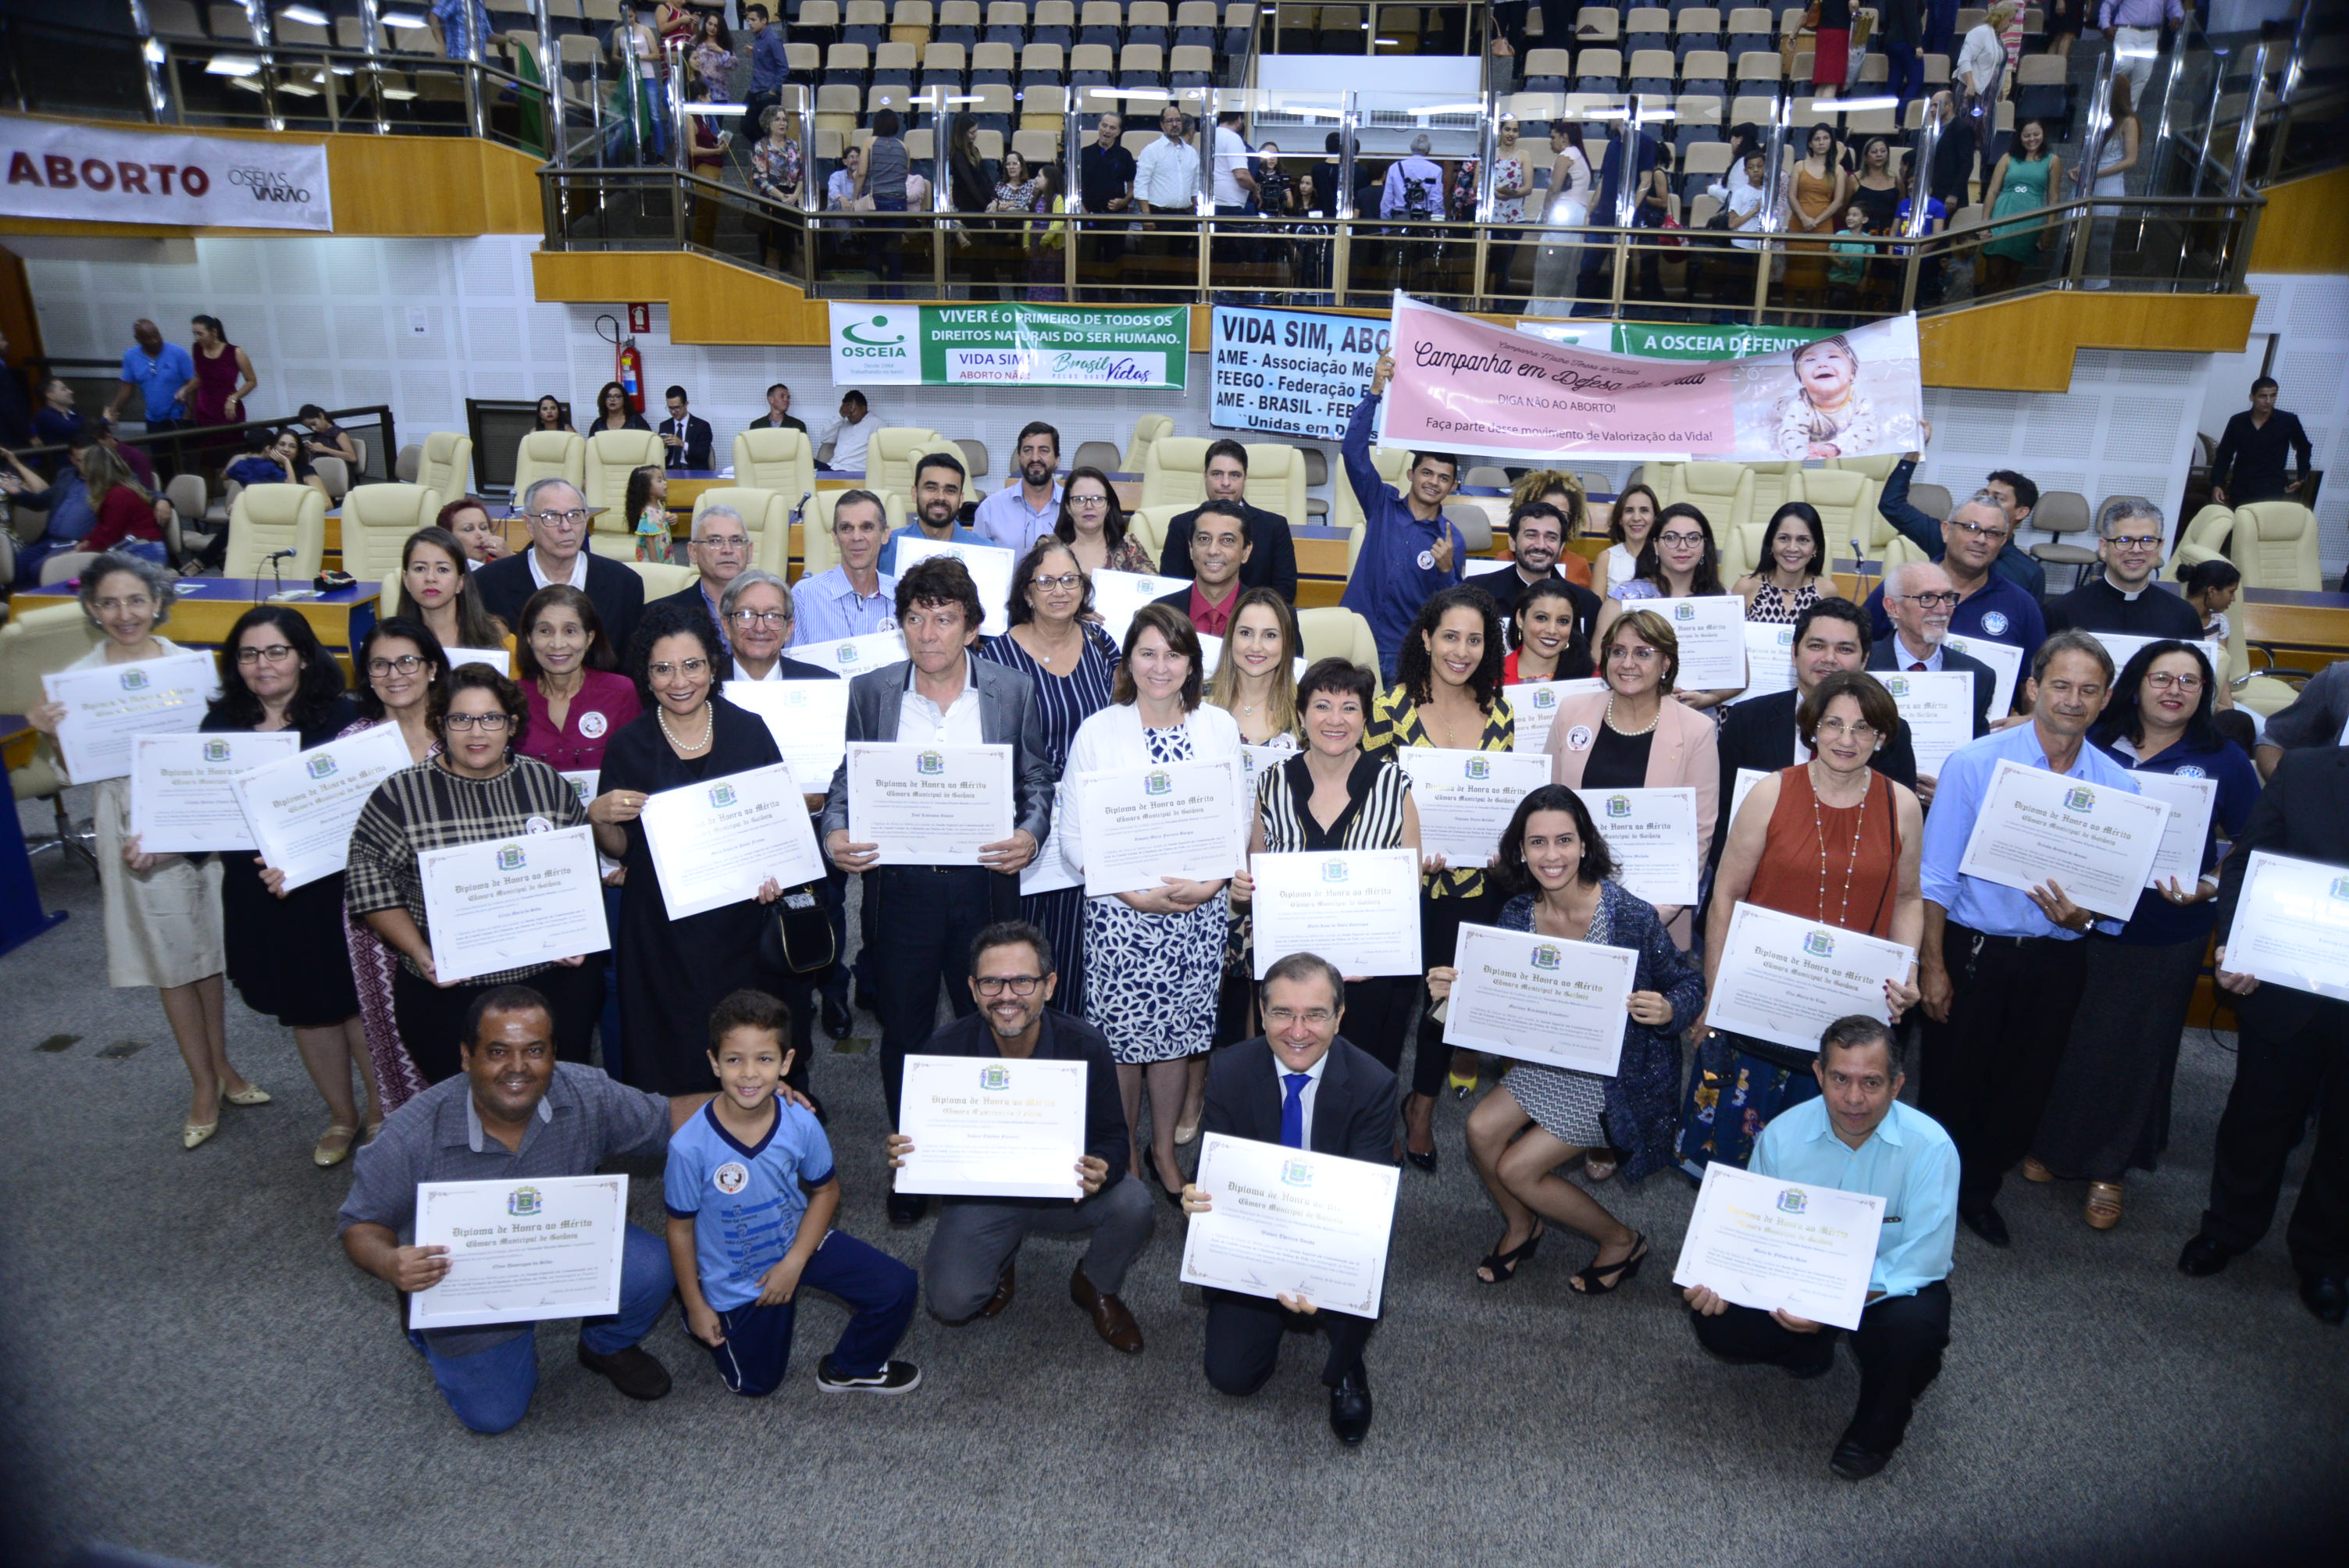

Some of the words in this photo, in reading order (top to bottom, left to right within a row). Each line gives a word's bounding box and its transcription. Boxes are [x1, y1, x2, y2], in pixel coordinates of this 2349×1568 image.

[8, 151, 209, 198] ABORTO
[939, 310, 988, 323] VIVER
[991, 310, 999, 323] É
[1002, 312, 1012, 323] O
[1016, 312, 1081, 325] PRIMEIRO
[1084, 315, 1101, 325] DE
[1105, 315, 1150, 326] TODOS
[1154, 315, 1172, 326] OS
[932, 330, 991, 340] DIREITOS
[994, 330, 1060, 342] NATURAIS
[1064, 332, 1083, 342] DO
[1087, 332, 1111, 343] SER
[1114, 333, 1181, 344] HUMANO.
[1222, 315, 1276, 345] VIDA
[1285, 320, 1332, 356] SIM,
[1644, 336, 1656, 349] A
[1661, 336, 1725, 351] OSCEIA
[842, 347, 906, 357] OSCEIA
[960, 354, 994, 364] VIDA
[1052, 352, 1110, 373] Brasil
[1106, 358, 1152, 382] Vidas
[1217, 349, 1248, 365] AME
[1261, 353, 1347, 378] Associação
[1414, 340, 1513, 376] Campanha
[1517, 363, 1546, 380] em
[1552, 370, 1623, 391] Defesa
[960, 371, 1002, 380] ABORTO
[1005, 370, 1031, 380] NÃ!
[1217, 370, 1264, 388] FEEGO
[1278, 376, 1355, 399] Federação
[1217, 391, 1245, 408] AME
[1259, 395, 1313, 415] BRASIL
[1498, 394, 1524, 406] DIGA
[1527, 396, 1549, 408] NÃO
[1552, 400, 1567, 410] AO
[1570, 401, 1616, 413] ABORTO!
[1306, 424, 1329, 434] em
[1426, 417, 1452, 432] Faça
[1455, 421, 1485, 433] parte
[1488, 422, 1518, 434] desse
[1521, 426, 1584, 440] movimento
[1587, 431, 1600, 441] de
[1602, 431, 1666, 444] Valorização
[1669, 432, 1682, 441] da
[1686, 430, 1712, 441] Vida!
[875, 779, 907, 787] Diploma
[960, 781, 986, 789] Mérito
[1104, 804, 1136, 814] Diploma
[1150, 800, 1174, 809] Honra
[1188, 793, 1214, 804] Mérito
[1646, 821, 1671, 830] Mérito
[2014, 801, 2048, 815] Diploma
[2062, 814, 2088, 826] Honra
[2102, 825, 2132, 839] Mérito
[454, 880, 489, 894] Diploma
[503, 873, 529, 884] Honra
[544, 865, 572, 877] Mérito
[1753, 946, 1788, 962] Diploma
[1802, 960, 1830, 972] Honra
[1845, 971, 1875, 984] Mérito
[1482, 965, 1517, 978] Diploma
[1531, 975, 1559, 985] Honra
[1574, 980, 1603, 992] Mérito
[1227, 1181, 1264, 1197] Diploma
[1281, 1192, 1310, 1205] Honra
[451, 1224, 493, 1238] Diploma
[497, 1224, 507, 1233] de
[511, 1221, 542, 1233] Honra
[559, 1217, 593, 1228] Mérito
[465, 1238, 497, 1249] Câmara
[500, 1235, 536, 1245] Municipal
[548, 1231, 577, 1240] Goiânia
